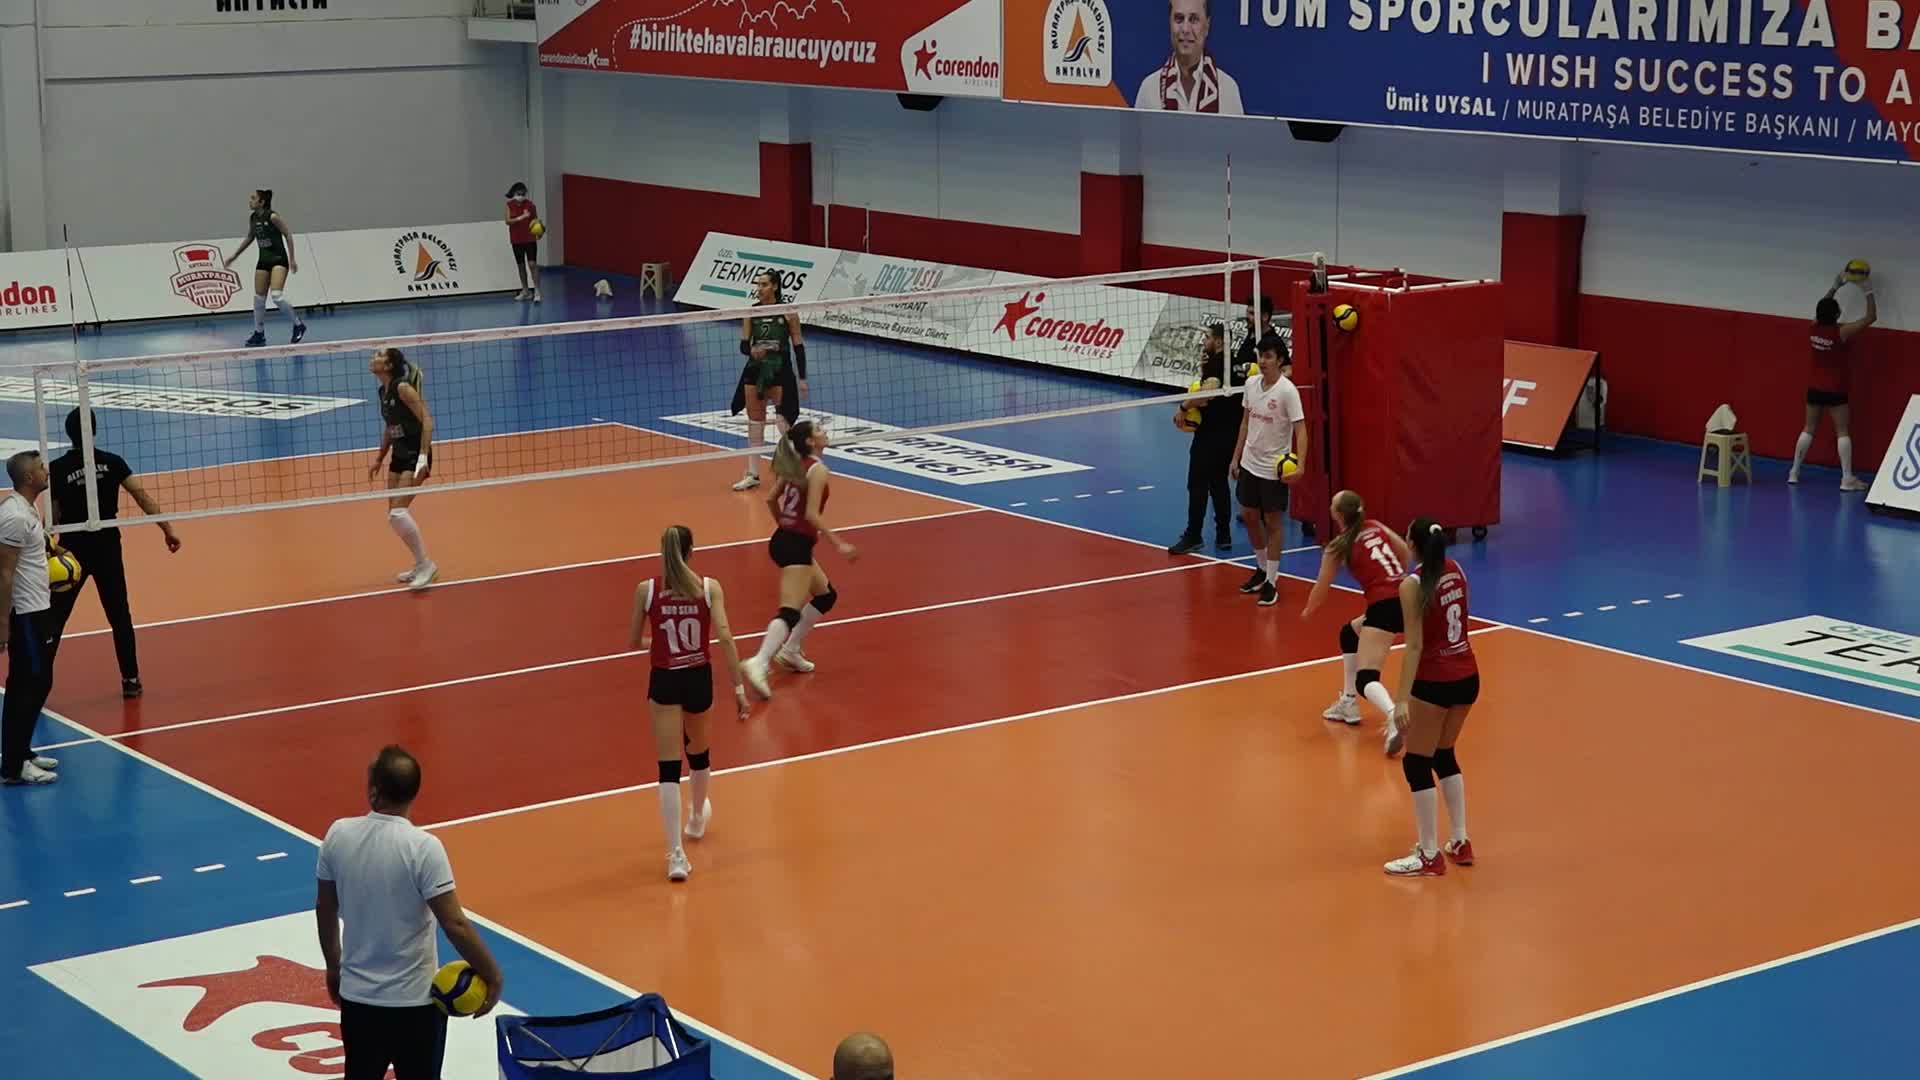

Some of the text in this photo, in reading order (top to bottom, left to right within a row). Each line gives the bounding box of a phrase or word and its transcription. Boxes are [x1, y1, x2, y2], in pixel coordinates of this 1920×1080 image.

[1348, 0, 1834, 47] SPORCULARIMIZA
[630, 23, 877, 69] #birliktehavalaraucuyoruz
[935, 55, 999, 79] corendon
[1055, 66, 1101, 79] ANTALYA
[1482, 51, 1920, 105] I WISH SUCCESS TO A
[1386, 86, 1429, 113] Ümit
[1435, 94, 1497, 117] UYSAL
[1517, 100, 1631, 129] MURATPAŞA
[1638, 106, 1737, 132] BELEDİYE
[1745, 112, 1839, 140] BAŞKANI
[0, 280, 57, 306] don
[1024, 316, 1125, 349] corendon
[1061, 343, 1115, 359] AIRLINES
[779, 483, 800, 517] 12
[659, 617, 701, 654] 10
[1446, 603, 1463, 643] 8
